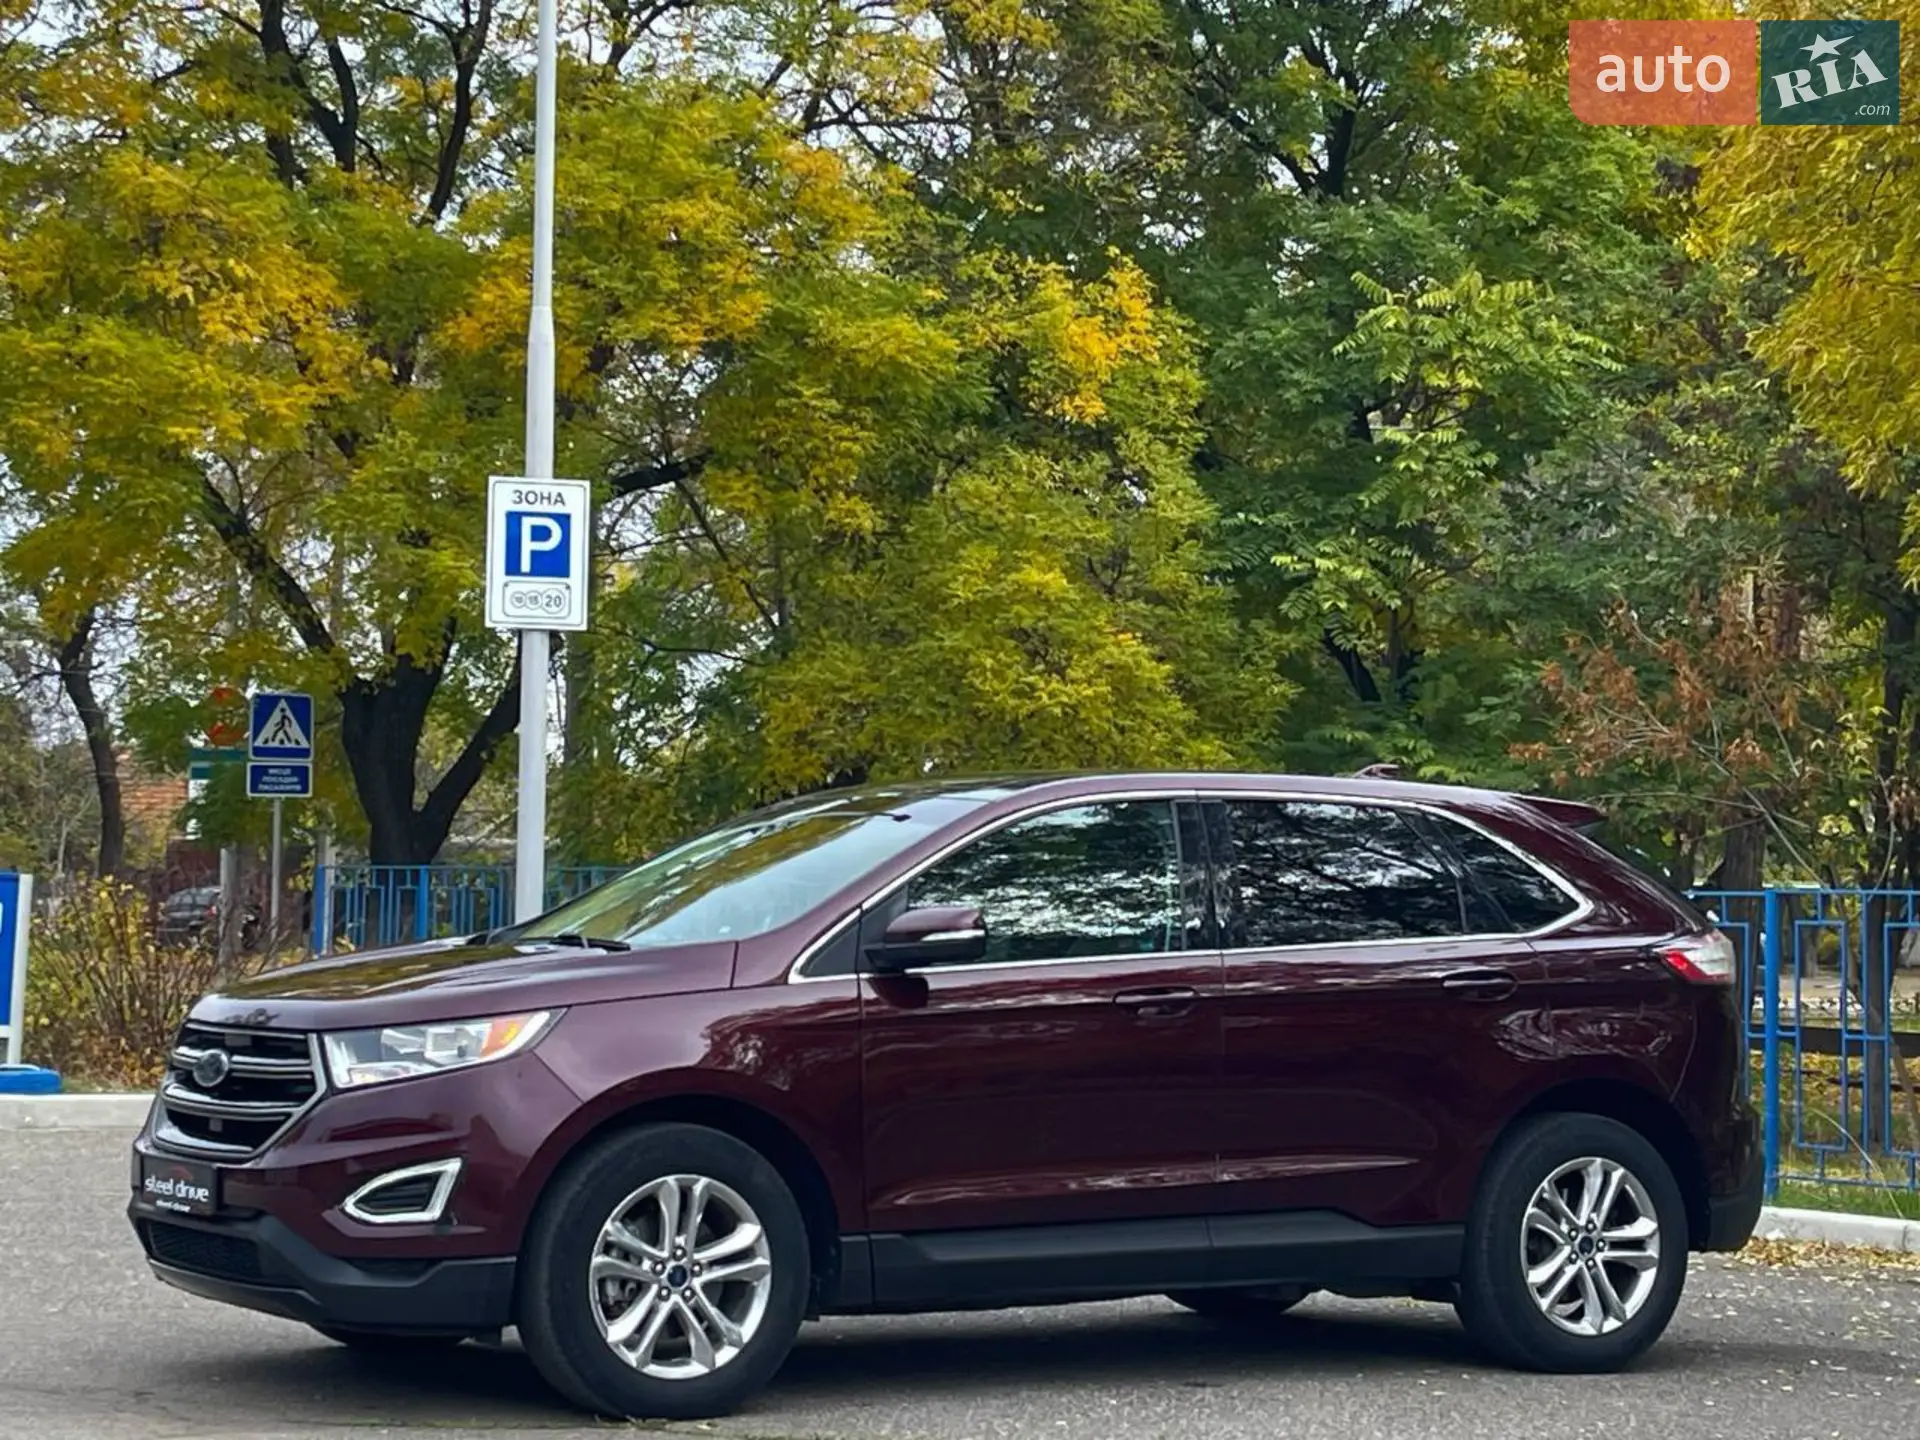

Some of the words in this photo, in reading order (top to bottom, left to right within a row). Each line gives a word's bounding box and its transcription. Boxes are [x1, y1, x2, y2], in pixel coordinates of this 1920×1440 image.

[512, 489, 566, 506] ЗОНА
[520, 516, 562, 573] P
[545, 594, 562, 609] 20
[144, 1175, 173, 1196] steel
[175, 1179, 209, 1202] drive
